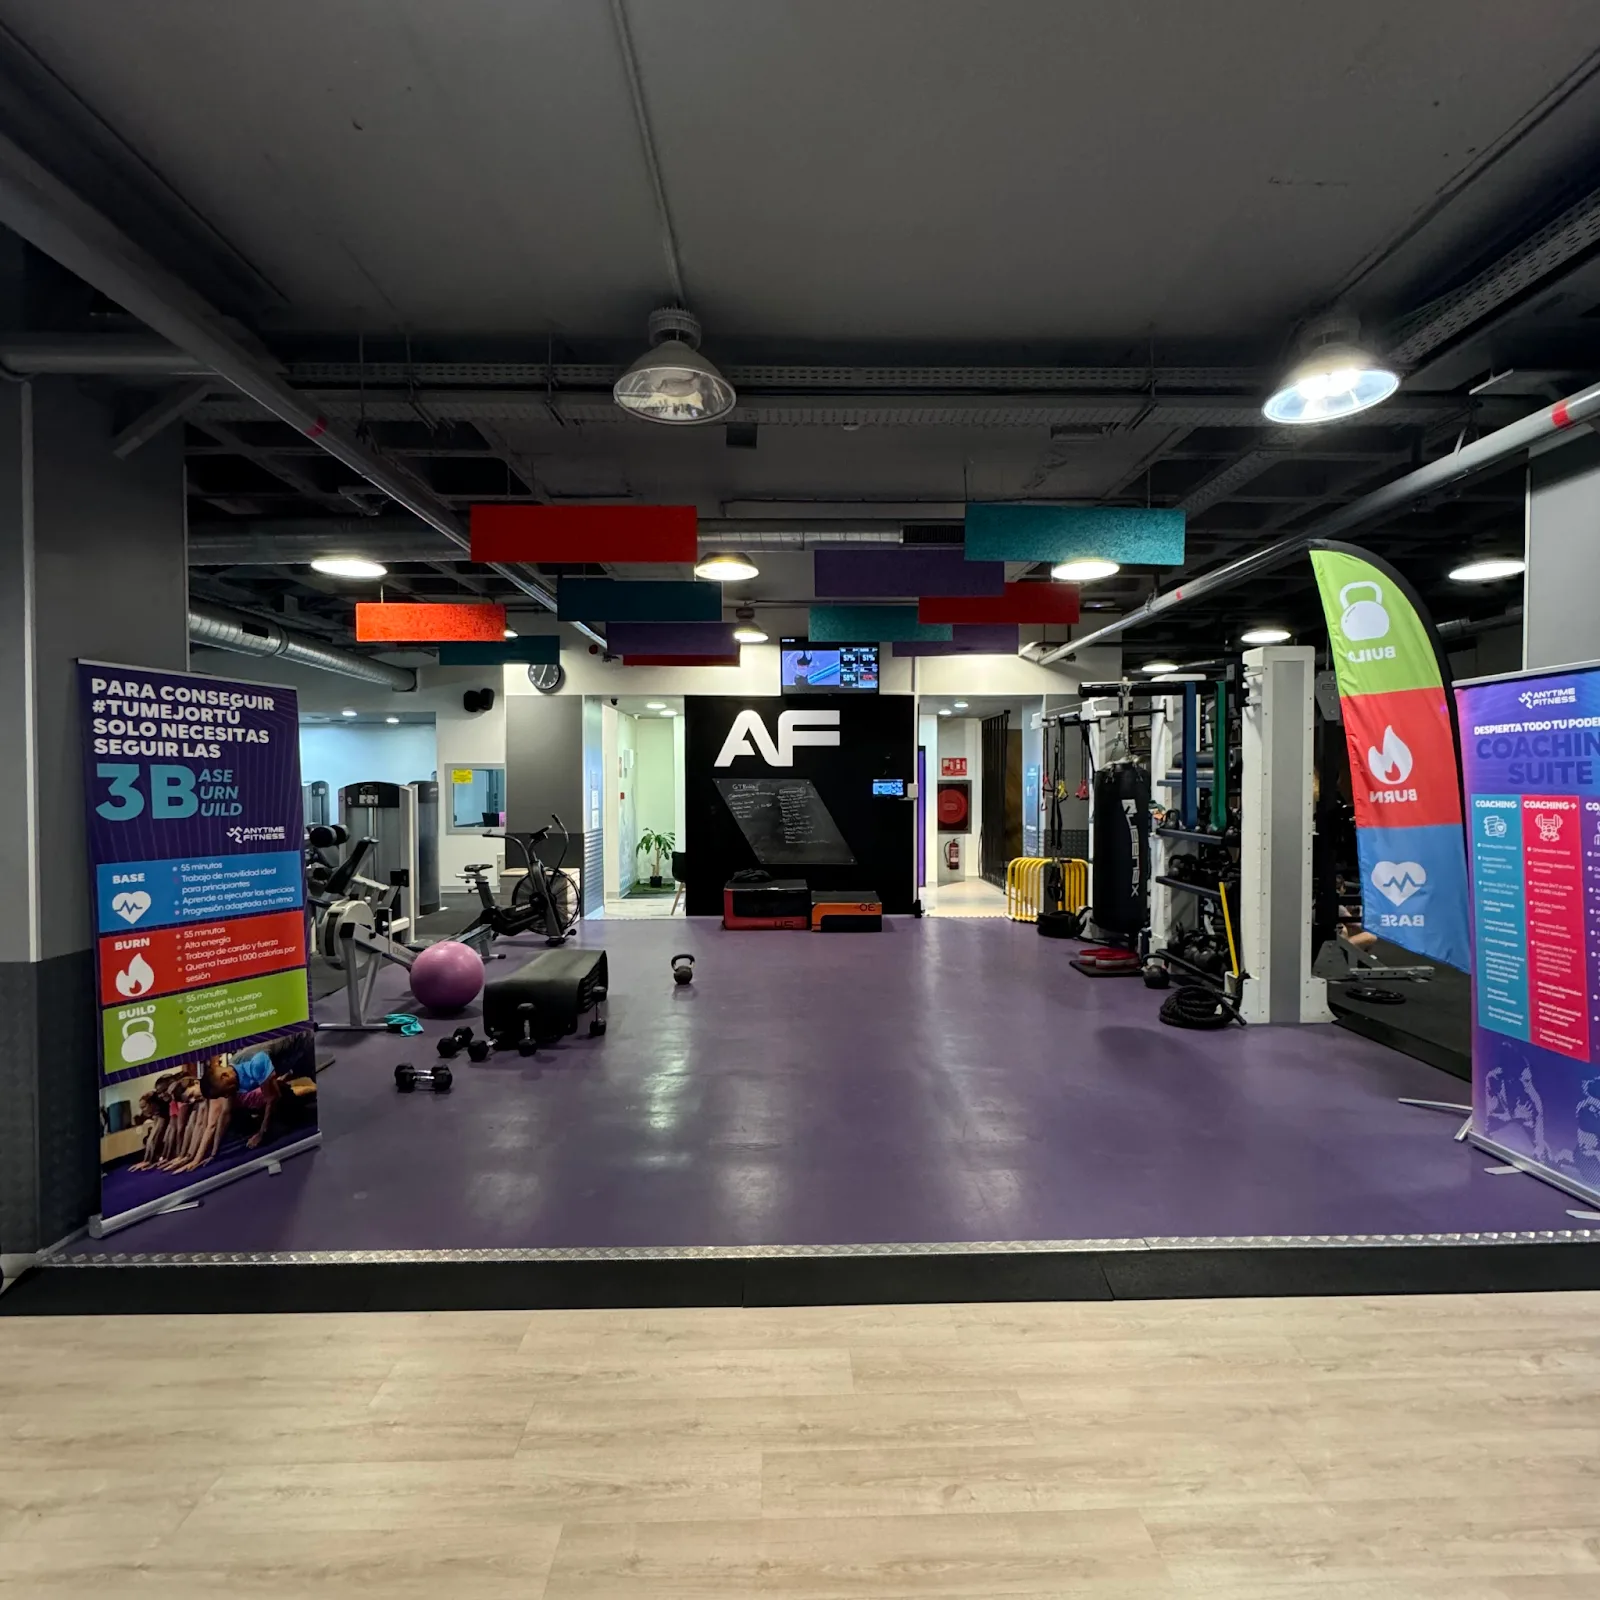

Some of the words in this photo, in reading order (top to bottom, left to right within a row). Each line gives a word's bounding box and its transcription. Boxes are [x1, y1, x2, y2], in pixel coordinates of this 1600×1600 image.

[92, 678, 157, 699] PARA
[160, 686, 274, 711] CONSEGUIR
[1533, 688, 1575, 699] ANYTIME
[1533, 695, 1576, 706] FITNESS
[92, 699, 240, 724] #TUMEJORTÚ
[93, 718, 157, 737] SOLO
[161, 722, 269, 743] NECESITAS
[1474, 722, 1522, 735] DESPIERTA
[1522, 720, 1551, 732] TODO
[1552, 719, 1567, 730] TU
[1568, 717, 1600, 729] PODE
[714, 710, 840, 767] AF
[1476, 732, 1600, 759] COACHIN
[94, 738, 179, 757] SEGUIR
[182, 743, 221, 758] LAS
[198, 769, 233, 782] ASE
[1507, 761, 1593, 785] SUITE
[200, 786, 239, 800] URN
[200, 803, 243, 817] UILD
[1475, 800, 1517, 809] COACHING
[243, 826, 284, 834] ANYTIME
[243, 832, 285, 841] FITNESS
[180, 864, 190, 872] 55
[191, 862, 222, 870] minutos
[181, 873, 211, 882] Trabajo
[223, 869, 260, 878] movilidad
[260, 867, 276, 875] ideal
[112, 872, 145, 884] BASE
[182, 886, 201, 895] para
[202, 881, 250, 893] principiantes
[182, 895, 216, 906] Aprende
[224, 891, 253, 901] ejecutar
[265, 886, 295, 896] ejercicios
[183, 904, 224, 916] Progresión
[225, 900, 261, 910] adaptada
[184, 930, 193, 939] 55
[194, 926, 226, 937] minutos
[114, 937, 150, 950] BURN
[184, 941, 200, 949] Alta
[201, 936, 231, 947] energía
[185, 950, 215, 960] Trabajo
[227, 943, 251, 953] cardio
[257, 939, 278, 948] fuerza
[185, 961, 216, 972] Quema
[217, 956, 238, 966] hasta
[239, 952, 257, 961] 1.000
[258, 948, 283, 958] calorías
[284, 946, 296, 955] por
[185, 972, 211, 983] sesión
[186, 994, 196, 1002] 55
[197, 988, 228, 999] minutos
[186, 999, 226, 1013] Construye
[236, 991, 262, 1003] cuerpo
[118, 1004, 156, 1021] BUILD
[187, 1011, 223, 1024] Aumenta
[233, 1003, 257, 1013] fuerza
[187, 1022, 226, 1036] Maximiza
[235, 1008, 278, 1024] rendimiento
[188, 1032, 226, 1047] deportivo
